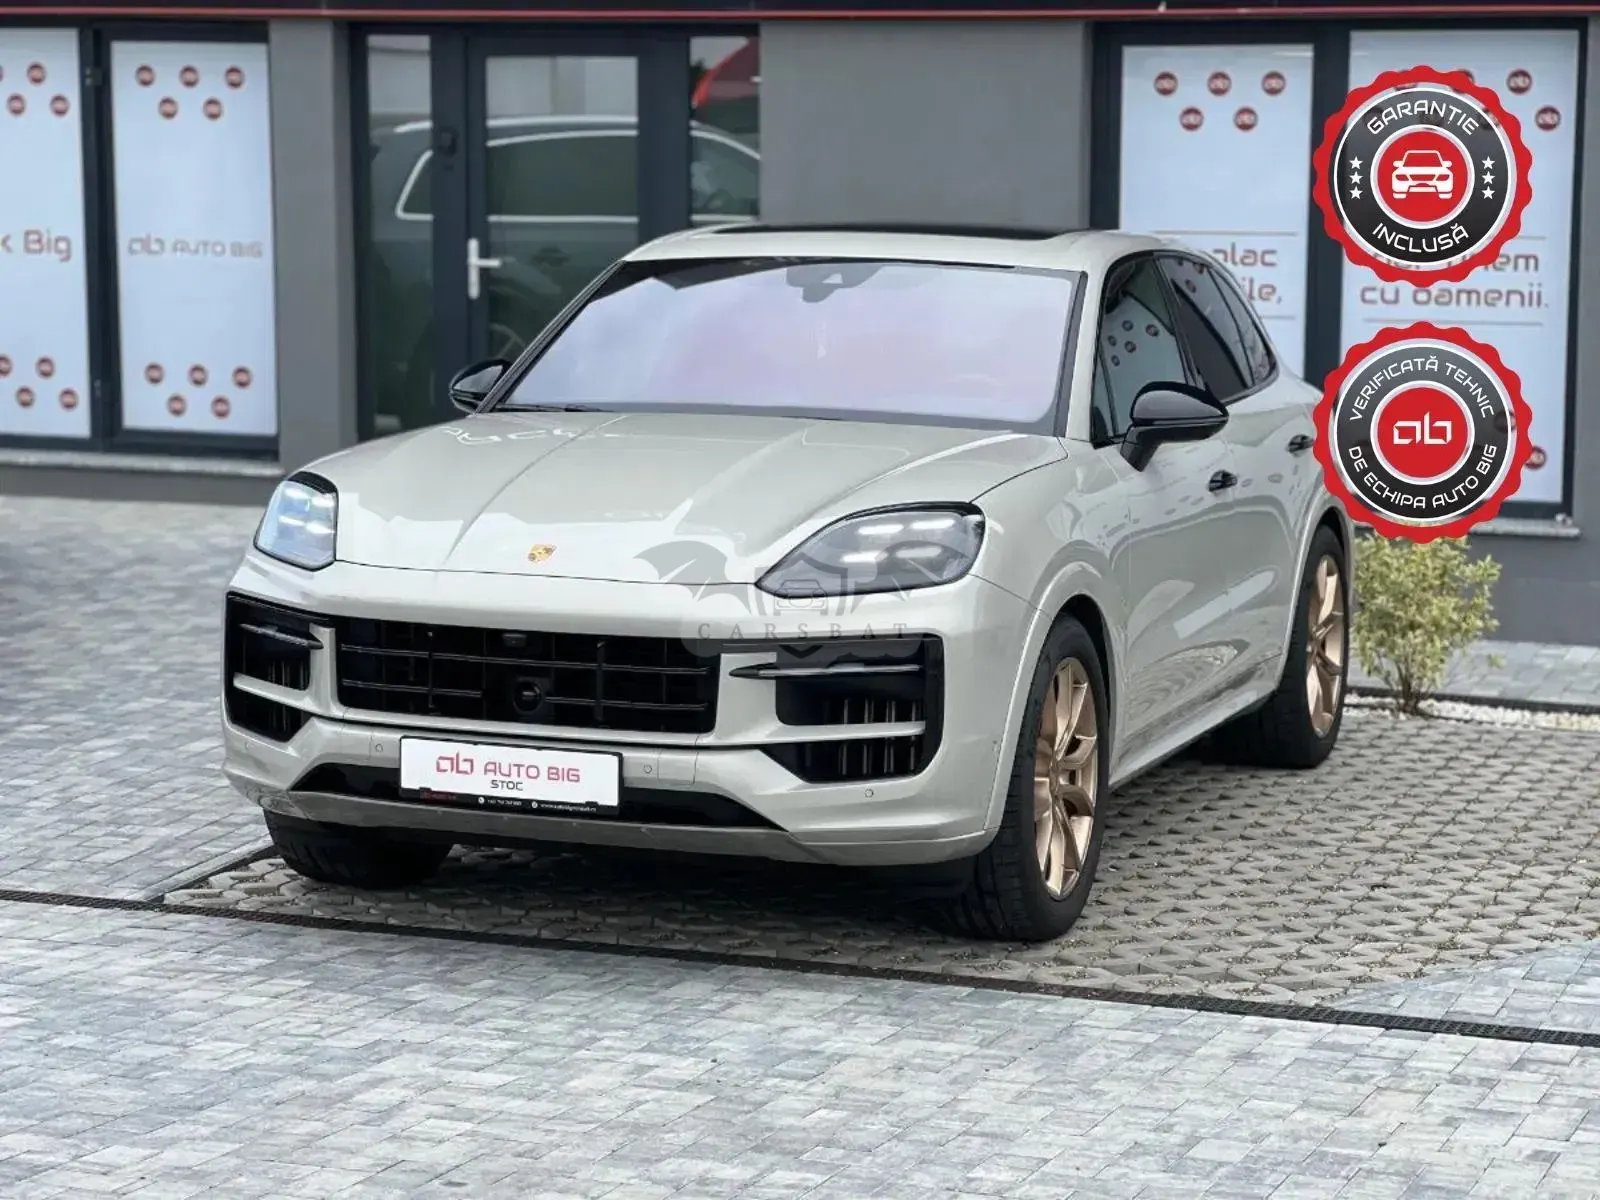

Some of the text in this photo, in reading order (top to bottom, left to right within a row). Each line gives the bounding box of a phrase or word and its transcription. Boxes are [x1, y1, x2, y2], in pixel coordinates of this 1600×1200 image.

[23, 229, 72, 262] Big
[172, 239, 226, 258] AUTO
[230, 241, 263, 258] BIG
[1359, 283, 1549, 309] cu oamenii.
[483, 760, 541, 780] AUTO
[547, 766, 581, 783] BIG
[490, 779, 524, 792] STOC
